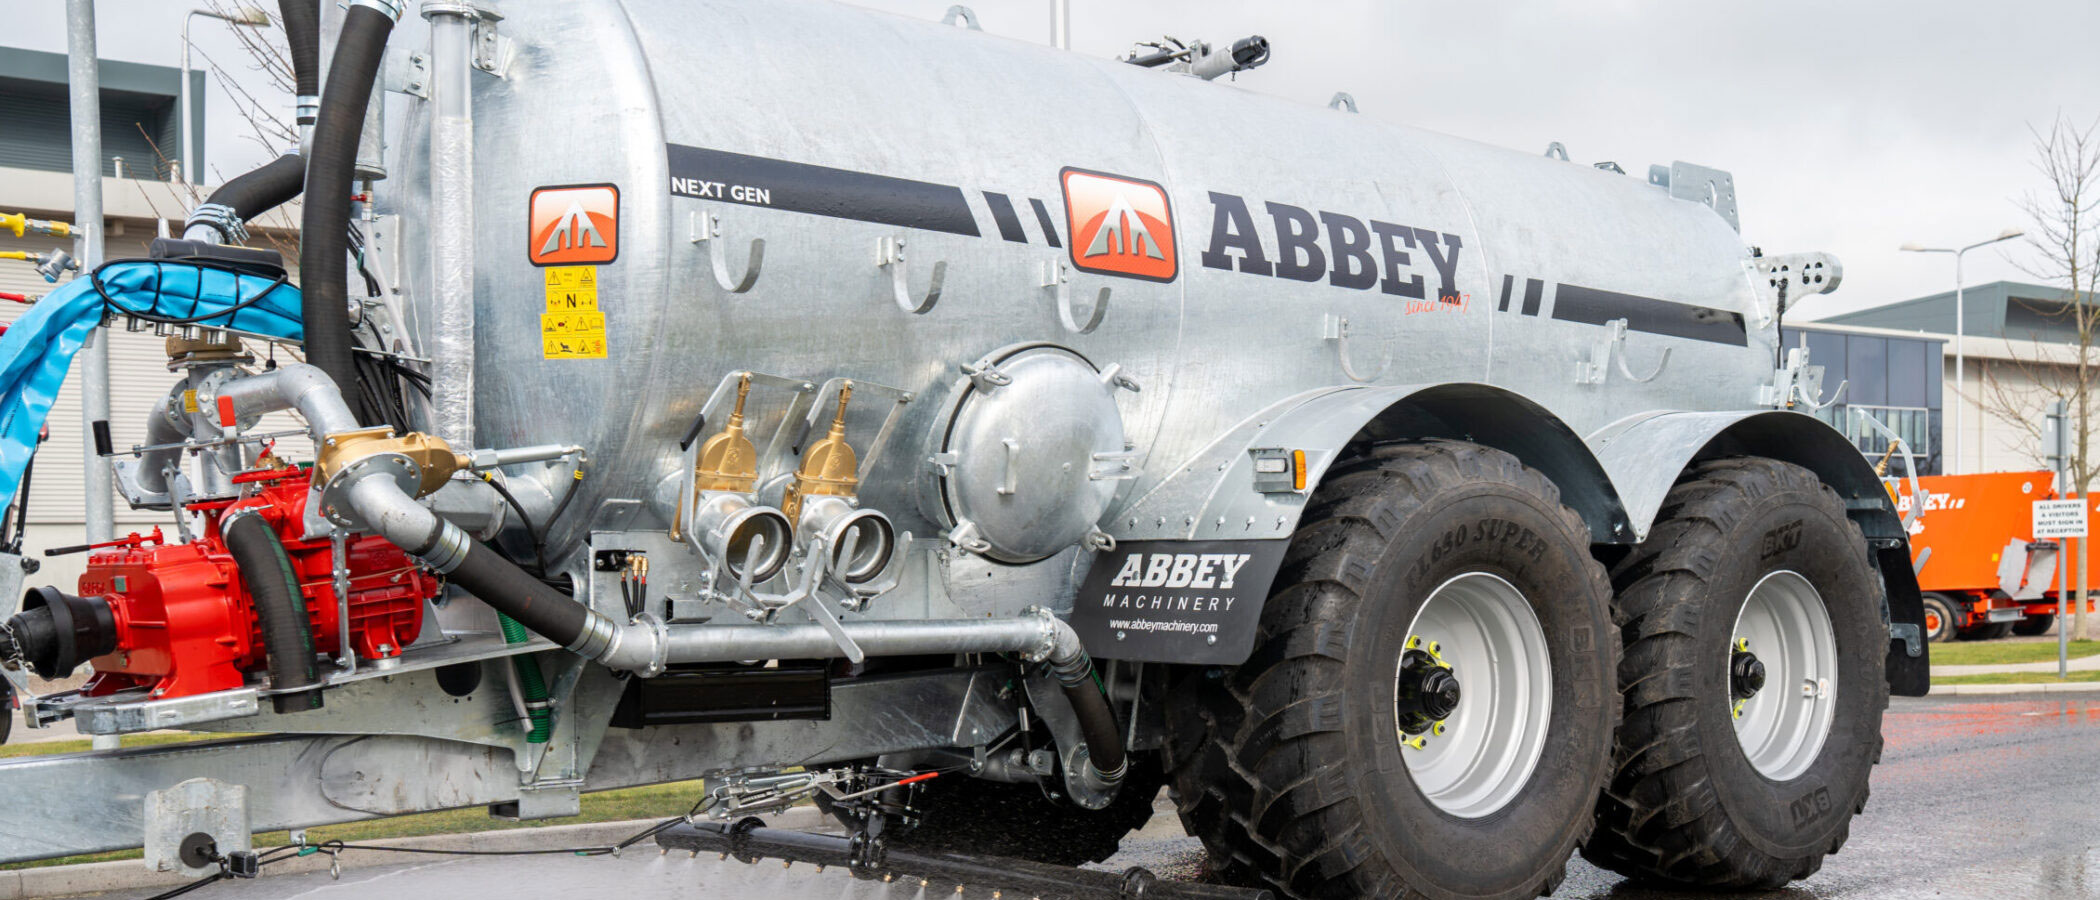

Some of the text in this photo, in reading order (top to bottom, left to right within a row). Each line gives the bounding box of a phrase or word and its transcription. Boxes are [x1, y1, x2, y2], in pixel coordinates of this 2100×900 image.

[671, 176, 771, 204] NEXT GEN
[1201, 190, 1463, 304] ABBEY
[1404, 294, 1471, 315] since 1947
[1472, 518, 1550, 564] SUPER
[1761, 519, 1803, 560] BKT
[1110, 553, 1251, 589] ABBEY
[1103, 594, 1236, 611] MACHINERY
[1109, 618, 1218, 635] www.abbeymachinery.com
[1790, 786, 1832, 832] BKT
